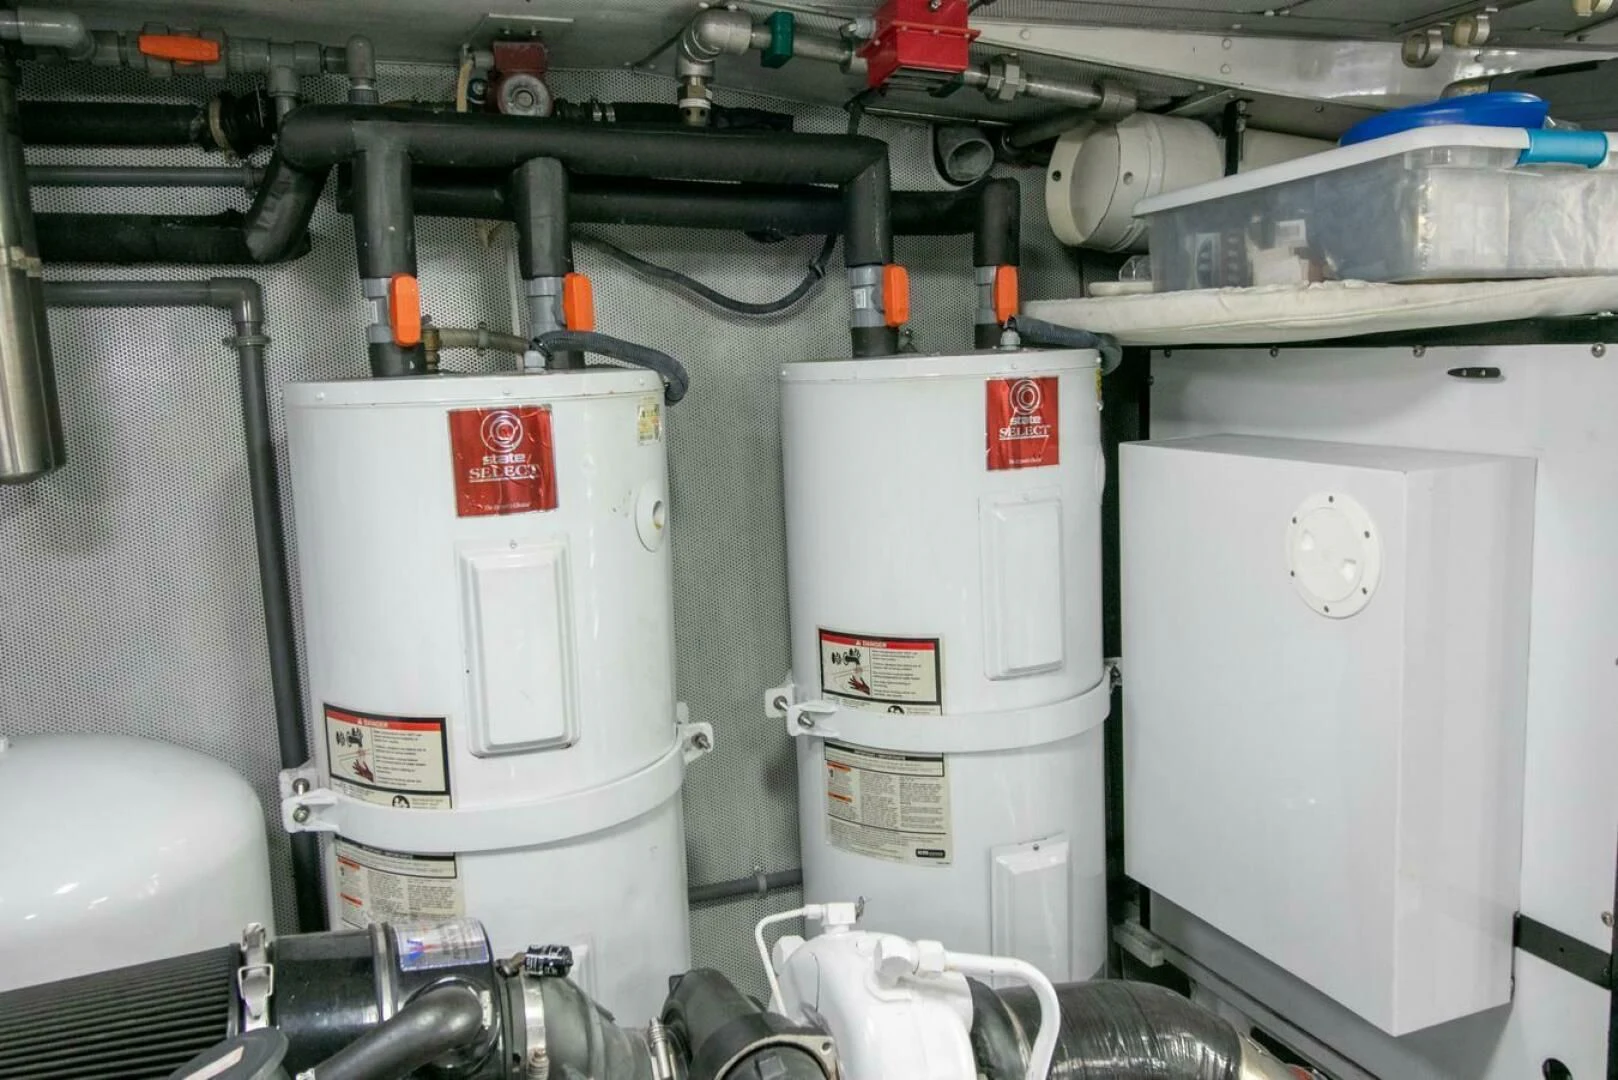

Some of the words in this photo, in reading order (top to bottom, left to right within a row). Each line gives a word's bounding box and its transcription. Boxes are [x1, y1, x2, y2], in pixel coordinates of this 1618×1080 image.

[1011, 416, 1041, 424] state
[999, 425, 1051, 437] SELECT
[482, 453, 525, 465] state
[469, 464, 538, 479] SELECT
